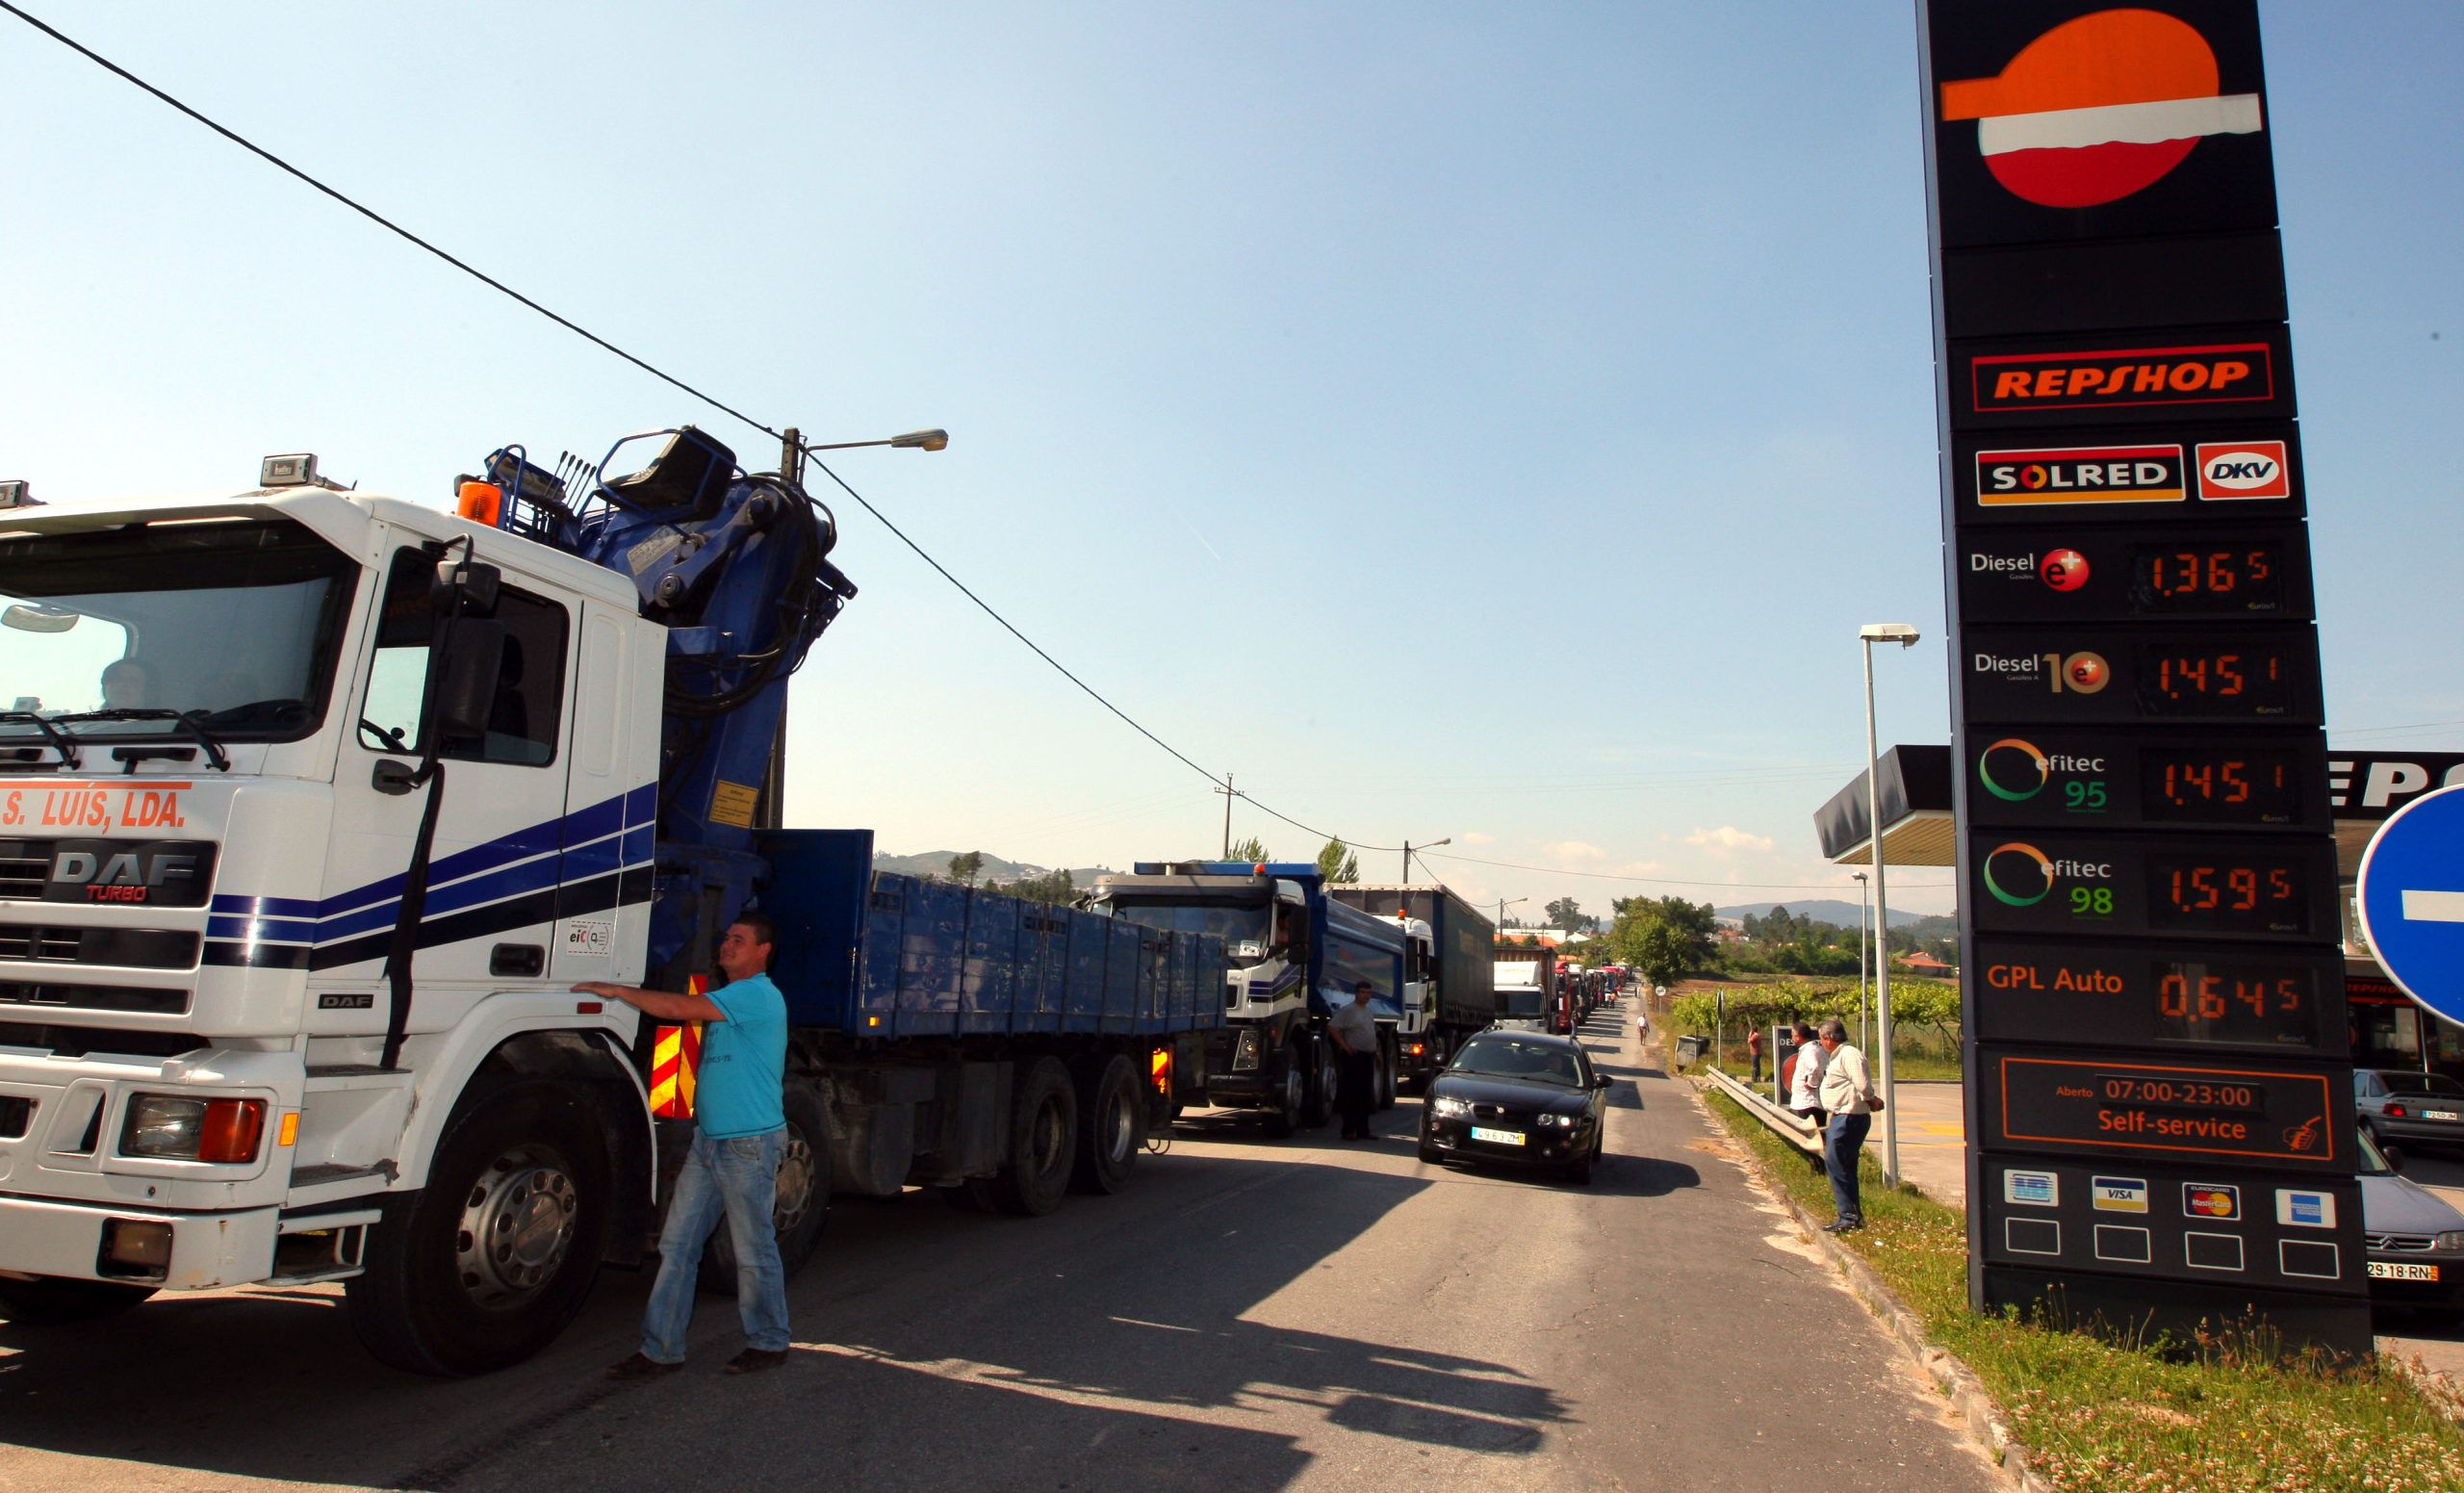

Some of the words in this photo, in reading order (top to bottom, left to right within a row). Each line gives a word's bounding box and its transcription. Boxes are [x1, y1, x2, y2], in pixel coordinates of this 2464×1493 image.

[1993, 361, 2250, 399] REPSHOP
[1992, 462, 2168, 490] SOLRED
[2211, 461, 2273, 479] DKV
[1971, 553, 2035, 571] Diesel
[1975, 654, 2039, 672] Diesel
[2036, 755, 2105, 772] efitec
[2065, 781, 2108, 808] 95
[2, 790, 26, 827] S.
[120, 791, 186, 828] LDA.
[52, 852, 197, 887] DAF
[2040, 860, 2112, 878] efitec
[85, 885, 147, 902] TURBO
[2070, 887, 2114, 914] 98
[1988, 965, 2044, 990] GPL
[2054, 968, 2123, 993] Auto
[322, 994, 372, 1008] DAF
[2056, 1086, 2093, 1098] Aberto
[2106, 1079, 2250, 1107] 07:00-23:00
[2097, 1109, 2246, 1140] Self-service
[2108, 1190, 2133, 1199] VISA
